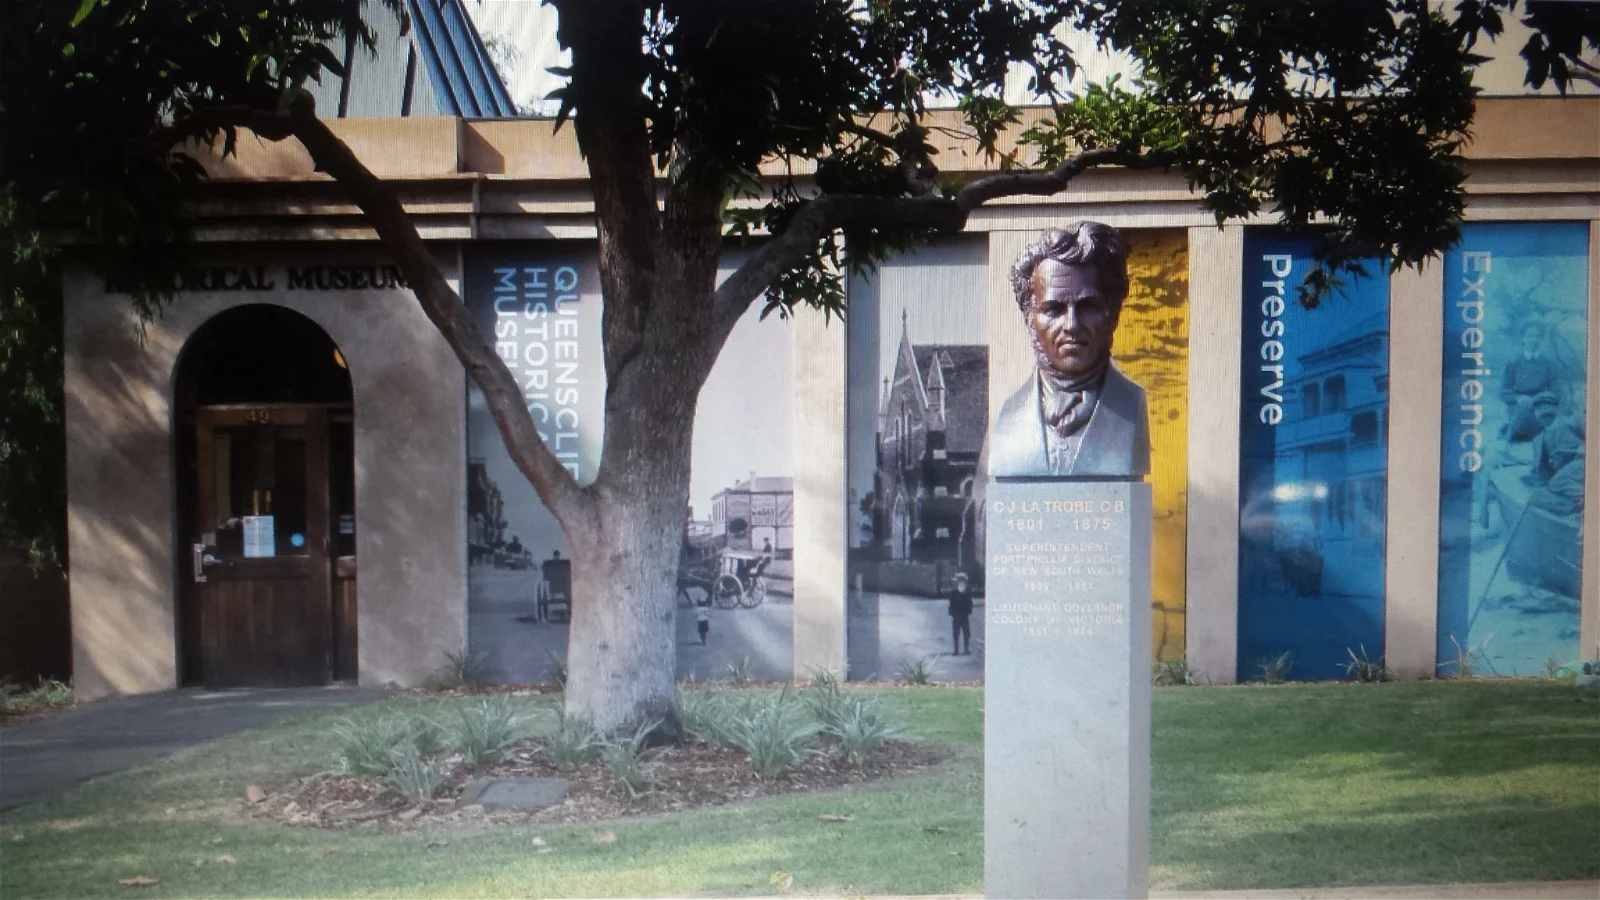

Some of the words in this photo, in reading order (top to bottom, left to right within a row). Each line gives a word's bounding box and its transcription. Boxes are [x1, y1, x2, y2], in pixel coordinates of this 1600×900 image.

[1259, 254, 1292, 426] Preserve
[1456, 251, 1491, 473] Experience
[246, 410, 270, 424] 49
[994, 500, 1004, 513] C
[1007, 500, 1016, 513] J
[1022, 500, 1040, 513] LA
[1043, 500, 1093, 513] TROBE
[1100, 500, 1110, 513] C
[1114, 500, 1124, 513] B
[1008, 518, 1043, 530] 1801
[1073, 518, 1110, 530] 1875
[1006, 543, 1108, 552] SUPERINTENDENT
[993, 554, 1024, 564] PORT
[1027, 554, 1068, 564] PHILLIP
[1074, 554, 1124, 564] DISTRICT
[993, 567, 1006, 576] OF
[1013, 567, 1037, 576] NEW
[1044, 567, 1080, 576] SOUTH
[1087, 567, 1124, 576] WALES
[992, 603, 1056, 612] LIEUTENANT
[1062, 603, 1124, 612] GOVERNOR
[992, 615, 1037, 624] COLONY
[1046, 615, 1059, 624] OF
[1069, 615, 1124, 624] VICTORIA
